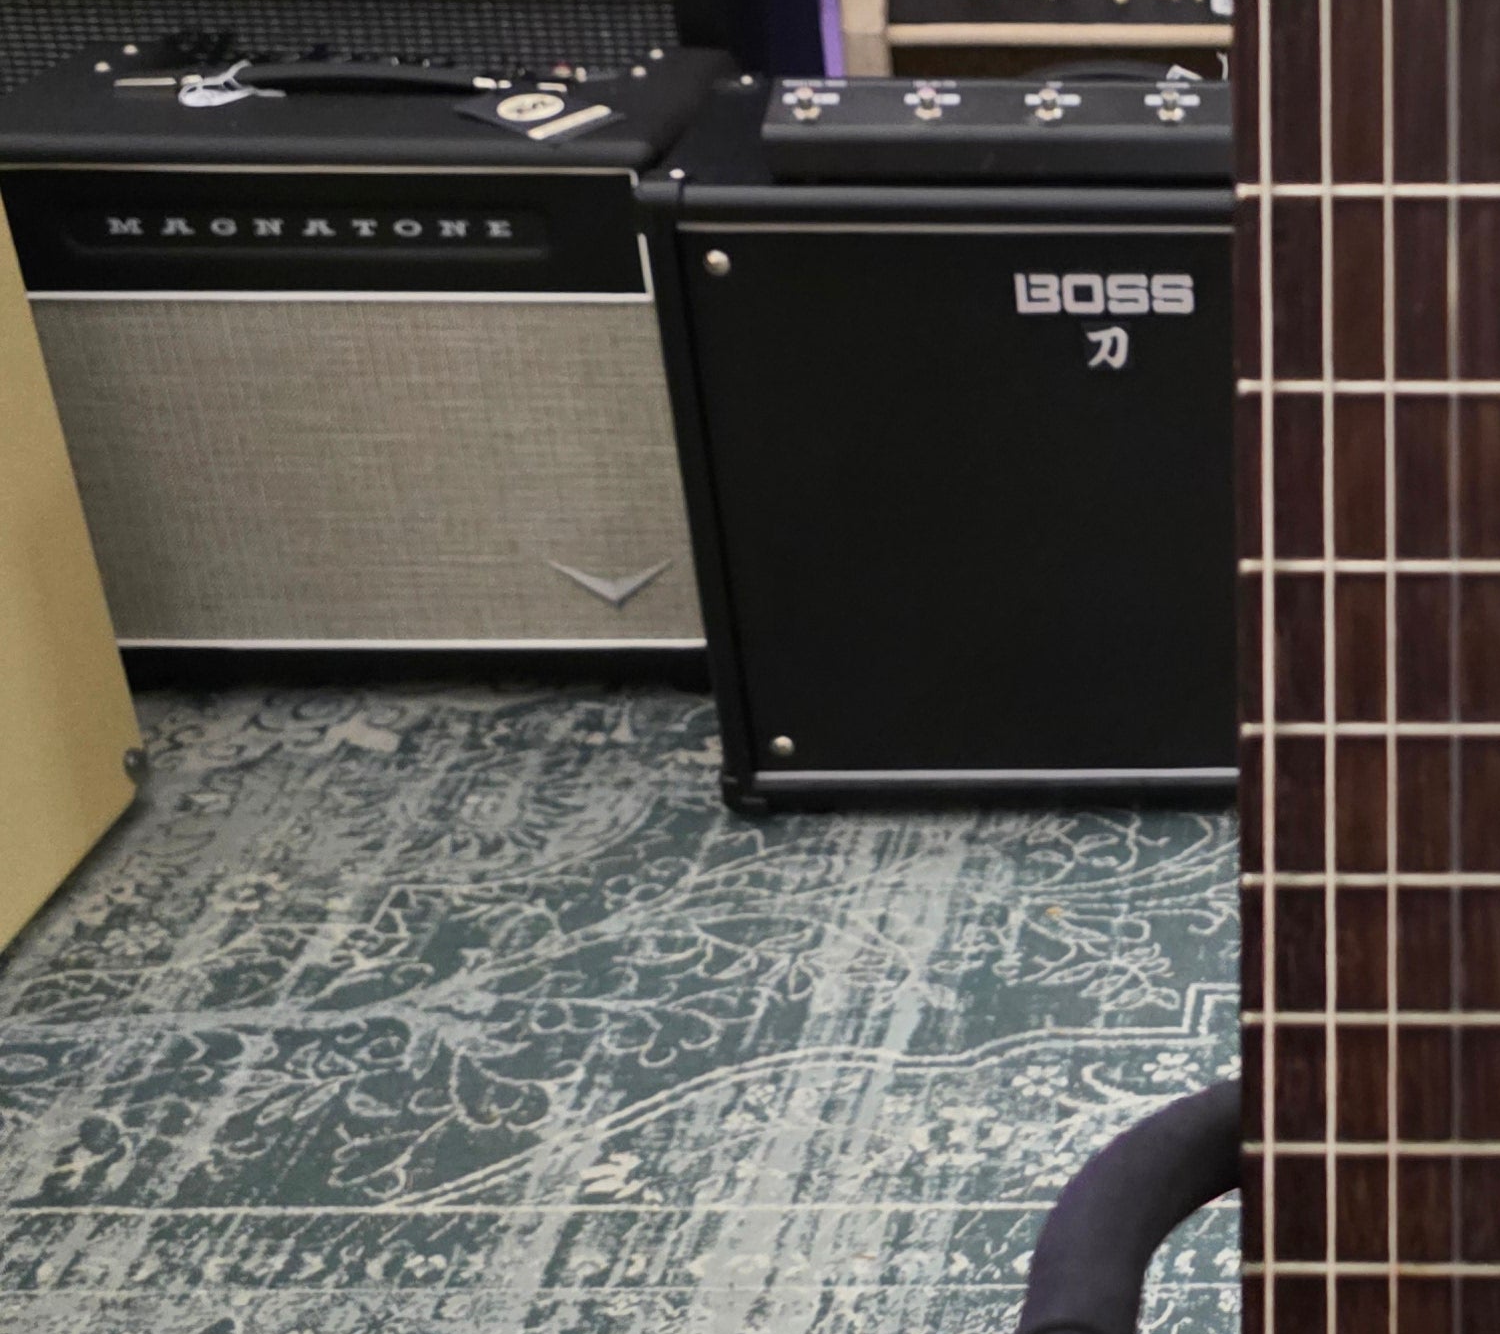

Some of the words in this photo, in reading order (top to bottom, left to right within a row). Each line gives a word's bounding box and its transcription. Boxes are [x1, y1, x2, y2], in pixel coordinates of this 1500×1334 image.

[106, 217, 513, 239] MAGNATONE
[1013, 273, 1195, 315] BOSS
[1085, 325, 1130, 369] 刀
